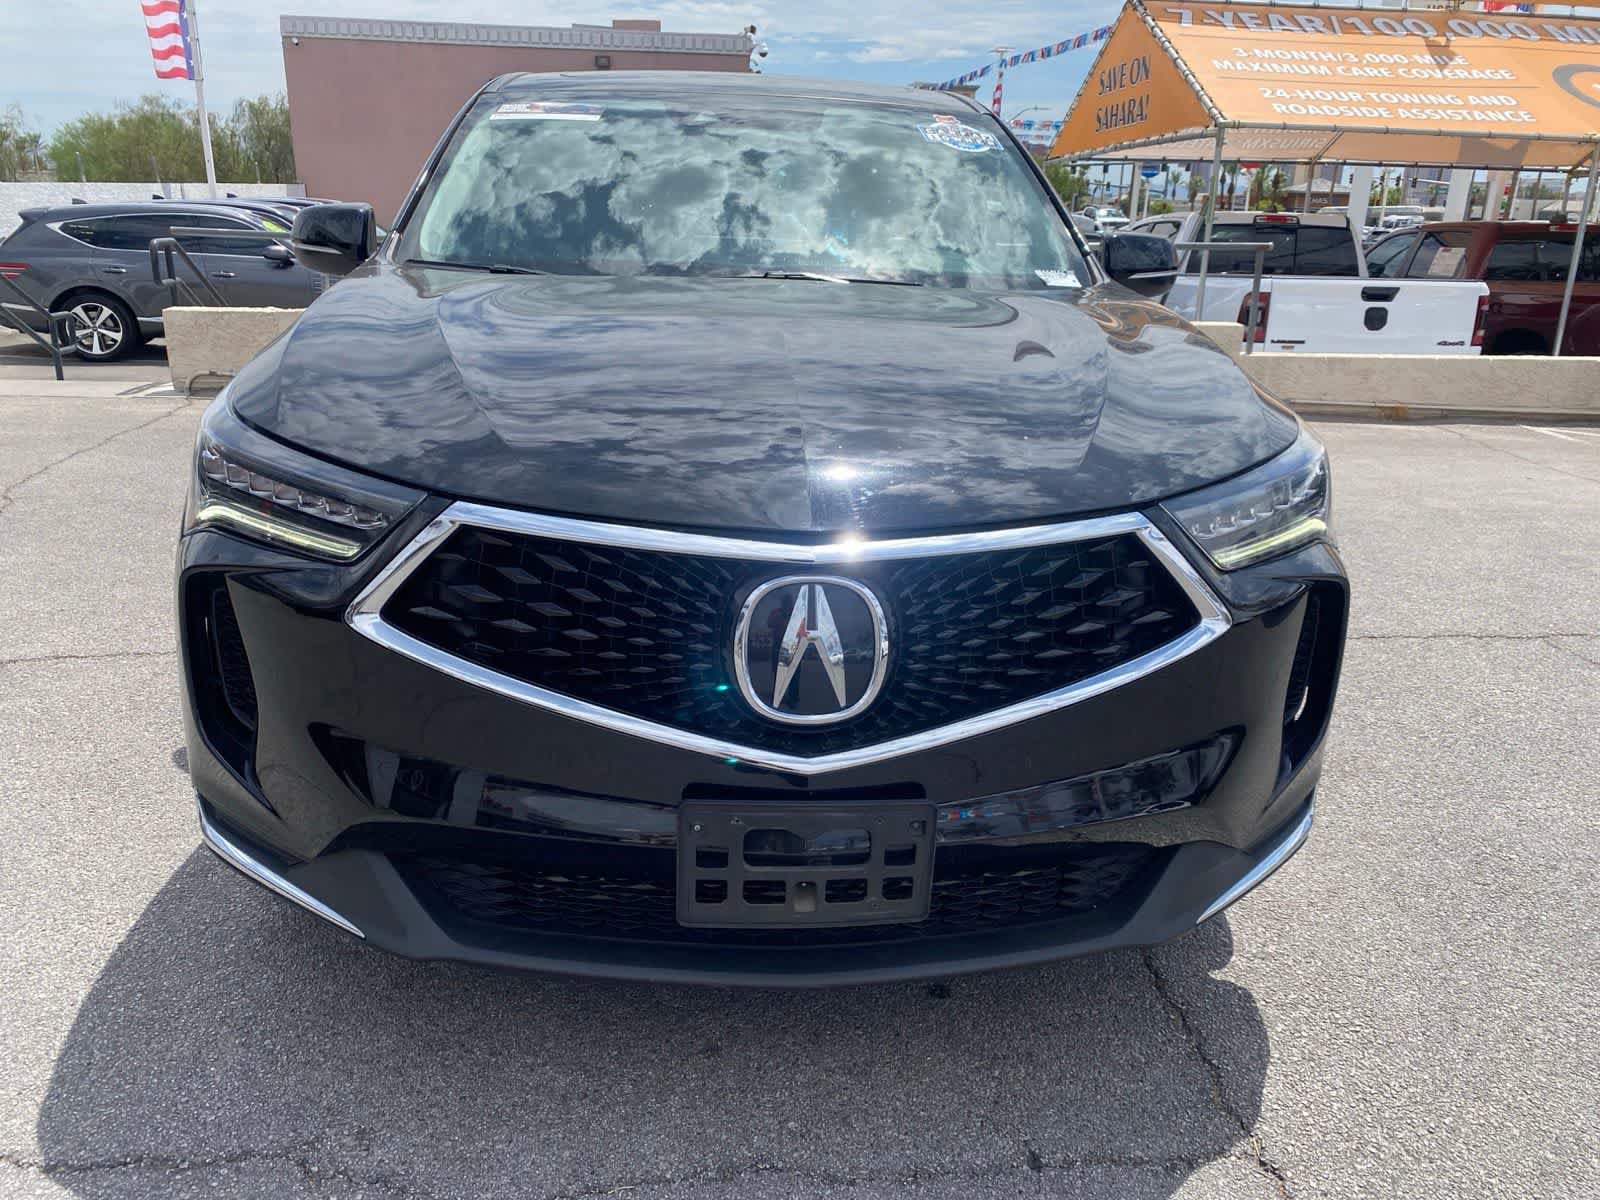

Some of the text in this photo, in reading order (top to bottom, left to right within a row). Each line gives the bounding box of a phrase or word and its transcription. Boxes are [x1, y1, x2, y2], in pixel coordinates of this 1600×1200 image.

[1166, 8, 1541, 41] 7-YEAR/100,000
[1231, 47, 1470, 65] 3-MONTH/3,000-MILE
[1098, 54, 1150, 95] SAVE ON
[1210, 59, 1518, 80] MAXIMUM CARE COVERAGE
[1258, 87, 1520, 106] 24-HOUR TOWING AND
[1095, 93, 1150, 132] SAHARA!
[1271, 103, 1538, 123] ROADSIDE ASSISTANCE
